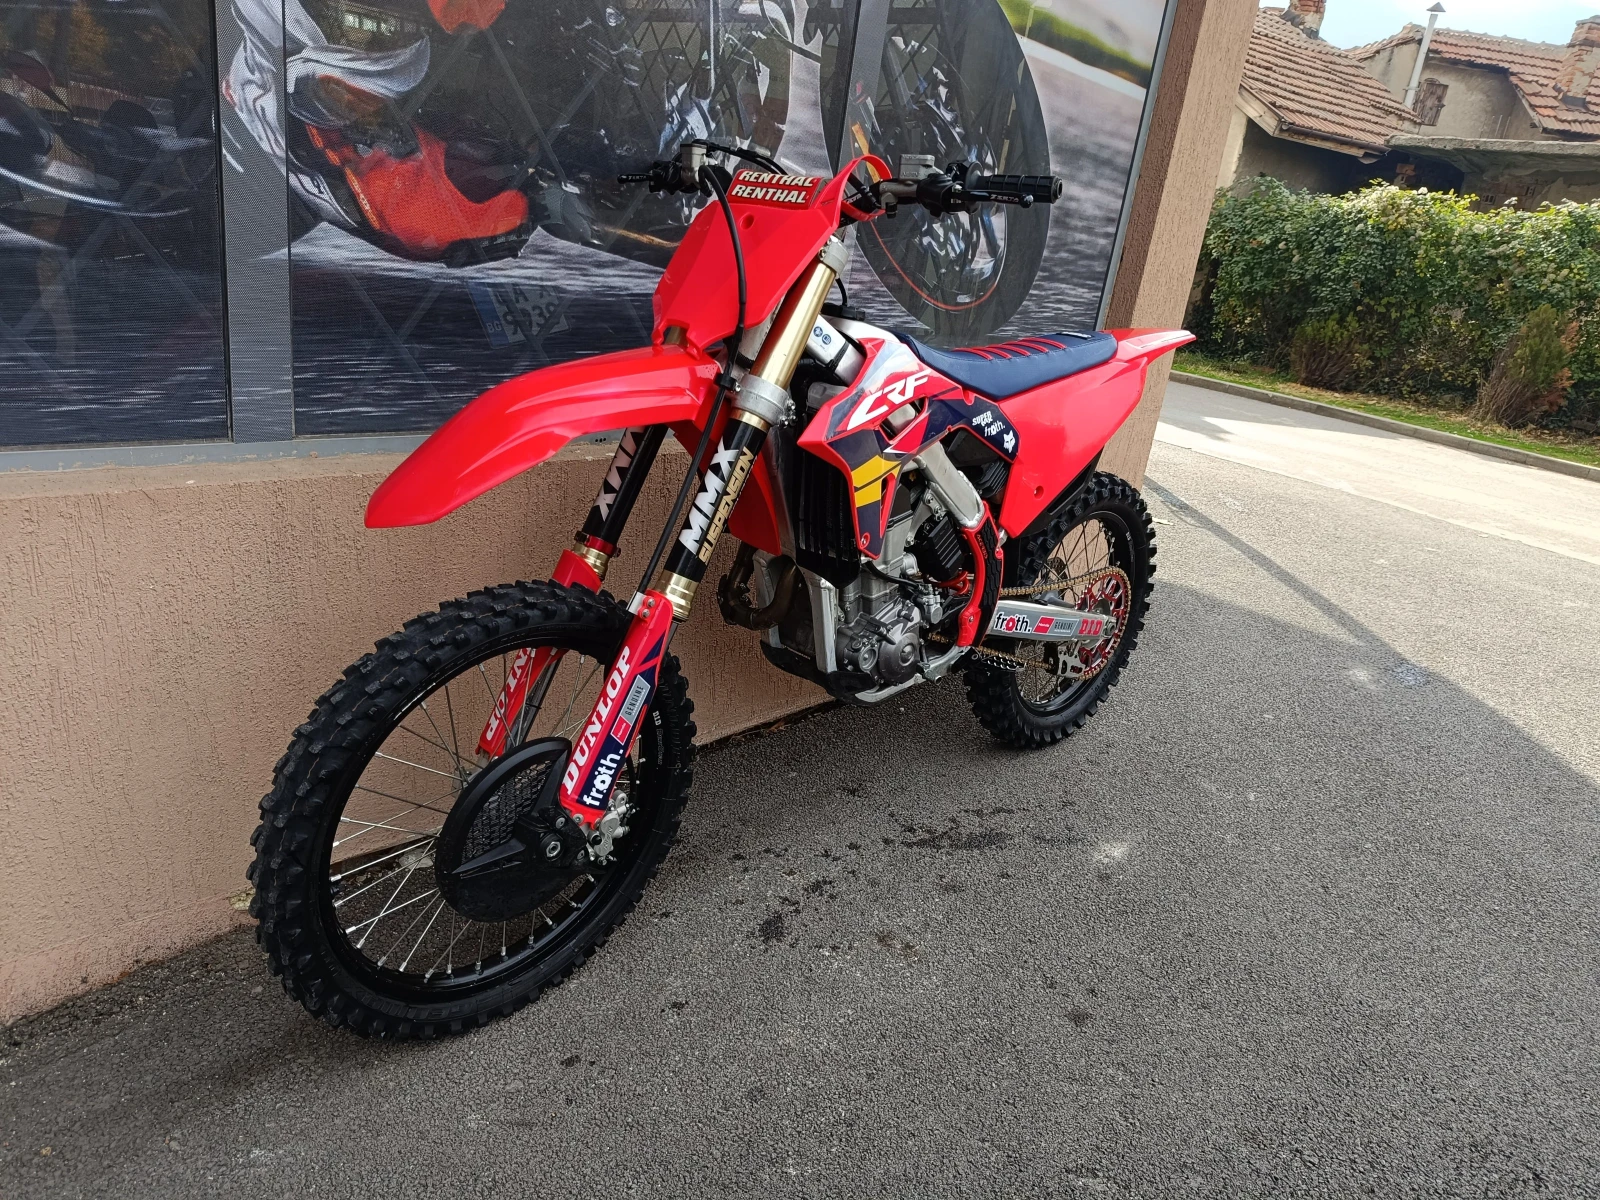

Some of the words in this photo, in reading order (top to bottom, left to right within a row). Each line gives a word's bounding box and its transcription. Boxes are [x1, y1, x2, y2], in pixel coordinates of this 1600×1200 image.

[731, 184, 807, 204] RENTHAL
[738, 170, 815, 187] RENTHAL
[847, 368, 932, 431] CRF
[678, 436, 740, 556] MMX
[698, 446, 758, 565] SUSPENSION
[995, 612, 1031, 634] froth.
[1054, 620, 1074, 631] GENUINE
[561, 646, 631, 795] DUNLOP
[624, 684, 645, 716] GENUINE
[582, 749, 624, 807] froth.
